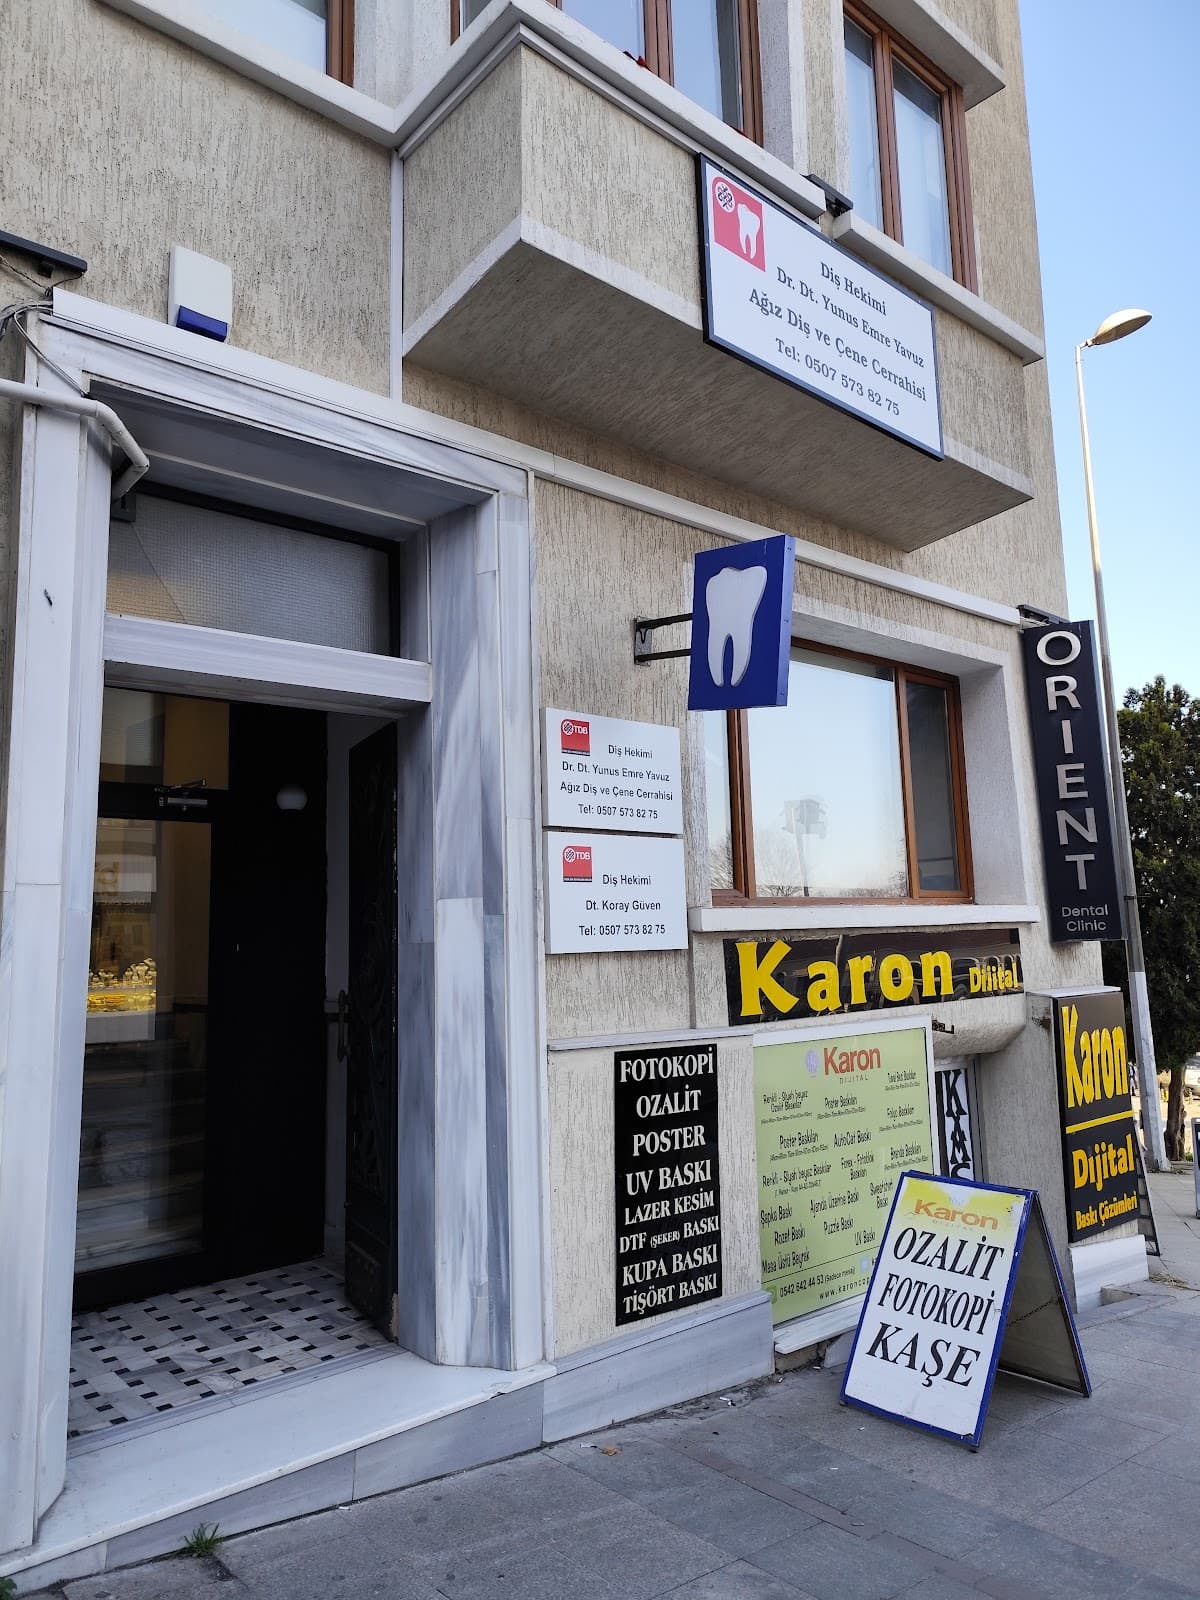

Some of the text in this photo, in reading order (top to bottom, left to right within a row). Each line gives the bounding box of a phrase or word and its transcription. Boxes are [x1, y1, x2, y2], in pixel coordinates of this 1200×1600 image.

[820, 262, 888, 316] Diş Hekimi
[776, 266, 925, 368] Dr. Dt. Yunus Emre Yavuz
[749, 288, 927, 402] Ağız Diş ve Çene Cerrahisi
[776, 338, 900, 416] Tel: 0507 573 82 75
[573, 724, 589, 735] TDB
[608, 744, 653, 759] Diş Hekimi
[1036, 630, 1098, 890] ORIENT
[562, 761, 670, 782] Dr. Dt. Yunus Emre Yavuz
[560, 782, 673, 801] Ağız Diş ve Çene Cerrahisi
[578, 803, 658, 819] Tel: 0507 573 82 75
[575, 851, 591, 861] TDB
[602, 874, 652, 887] Diş Hekimi
[585, 899, 661, 914] Dt. Koray Güven
[1062, 904, 1109, 918] Dental
[579, 924, 666, 936] Tel: 0507 573 82 75
[1066, 919, 1107, 932] Clinic
[735, 939, 954, 1016] Karon
[620, 1047, 714, 1083] FOTOKOPİ
[824, 1046, 881, 1076] Karon
[1061, 1004, 1129, 1108] Karon
[636, 1084, 701, 1118] OZALİT
[632, 1125, 706, 1157] POSTER
[626, 1159, 712, 1196] UV BASKI
[625, 1188, 714, 1225] LAZER KESİM
[779, 1202, 793, 1221] Baskı
[847, 1187, 860, 1205] Baskı
[1076, 1190, 1138, 1231] Baskı Çözümleri
[824, 1214, 854, 1236] Puzzle Baskı
[914, 1199, 999, 1231] Karon
[620, 1215, 720, 1254] DTF (ŞEKER) BASKI
[791, 1224, 806, 1242] Baskı
[863, 1227, 876, 1244] Baskı
[622, 1244, 718, 1287] KUPA BASKI
[893, 1227, 1005, 1281] OZALİT
[623, 1272, 718, 1315] TİŞÖRT BASKI
[780, 1284, 795, 1298] 0542
[808, 1277, 816, 1289] 44
[816, 1274, 824, 1286] 53
[877, 1273, 996, 1336] FOTOKOPİ
[865, 1322, 981, 1388] KAŞE
